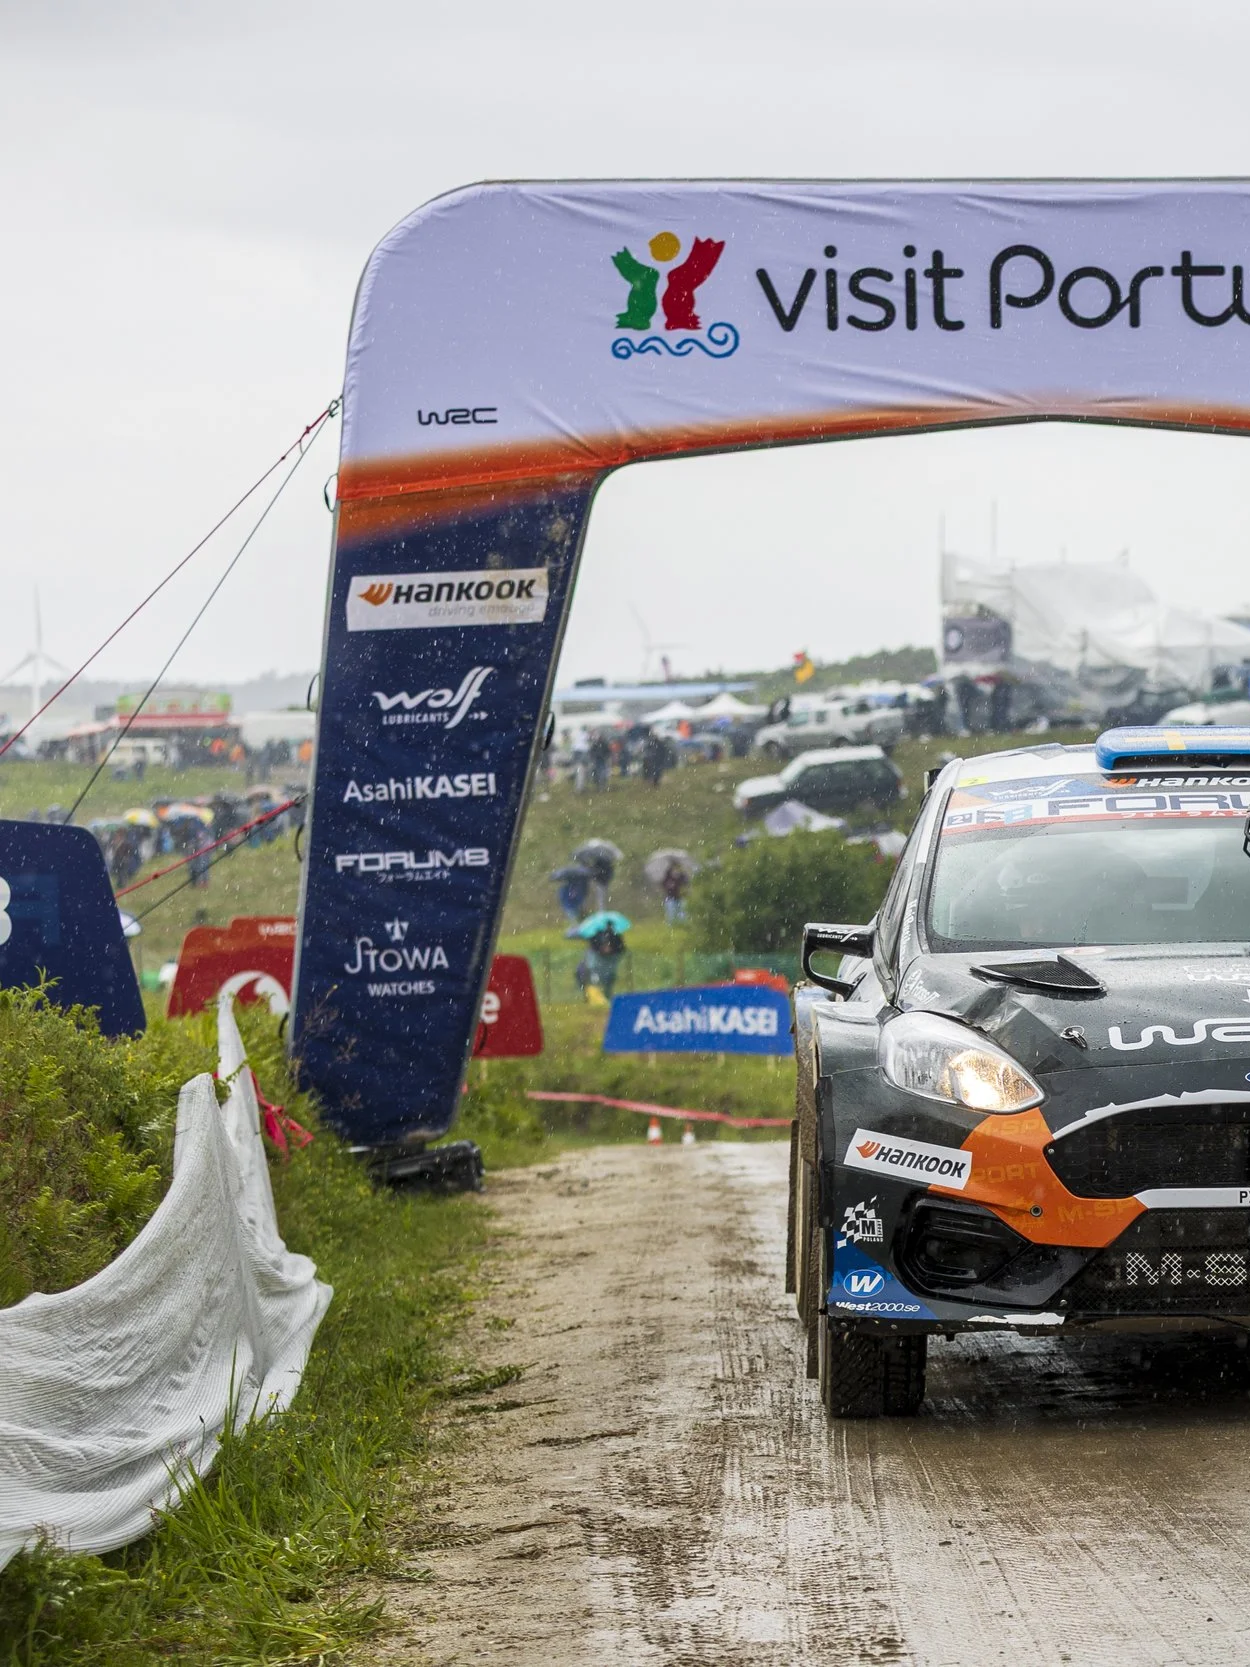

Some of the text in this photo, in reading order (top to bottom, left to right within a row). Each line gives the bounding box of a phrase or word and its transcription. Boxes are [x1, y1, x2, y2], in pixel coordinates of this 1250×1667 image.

[755, 246, 964, 332] visit
[418, 407, 498, 425] WRC
[382, 713, 450, 725] LUBRICANTS
[335, 848, 491, 872] FORUM8
[367, 980, 435, 997] WATCHES
[851, 1273, 883, 1292] W
